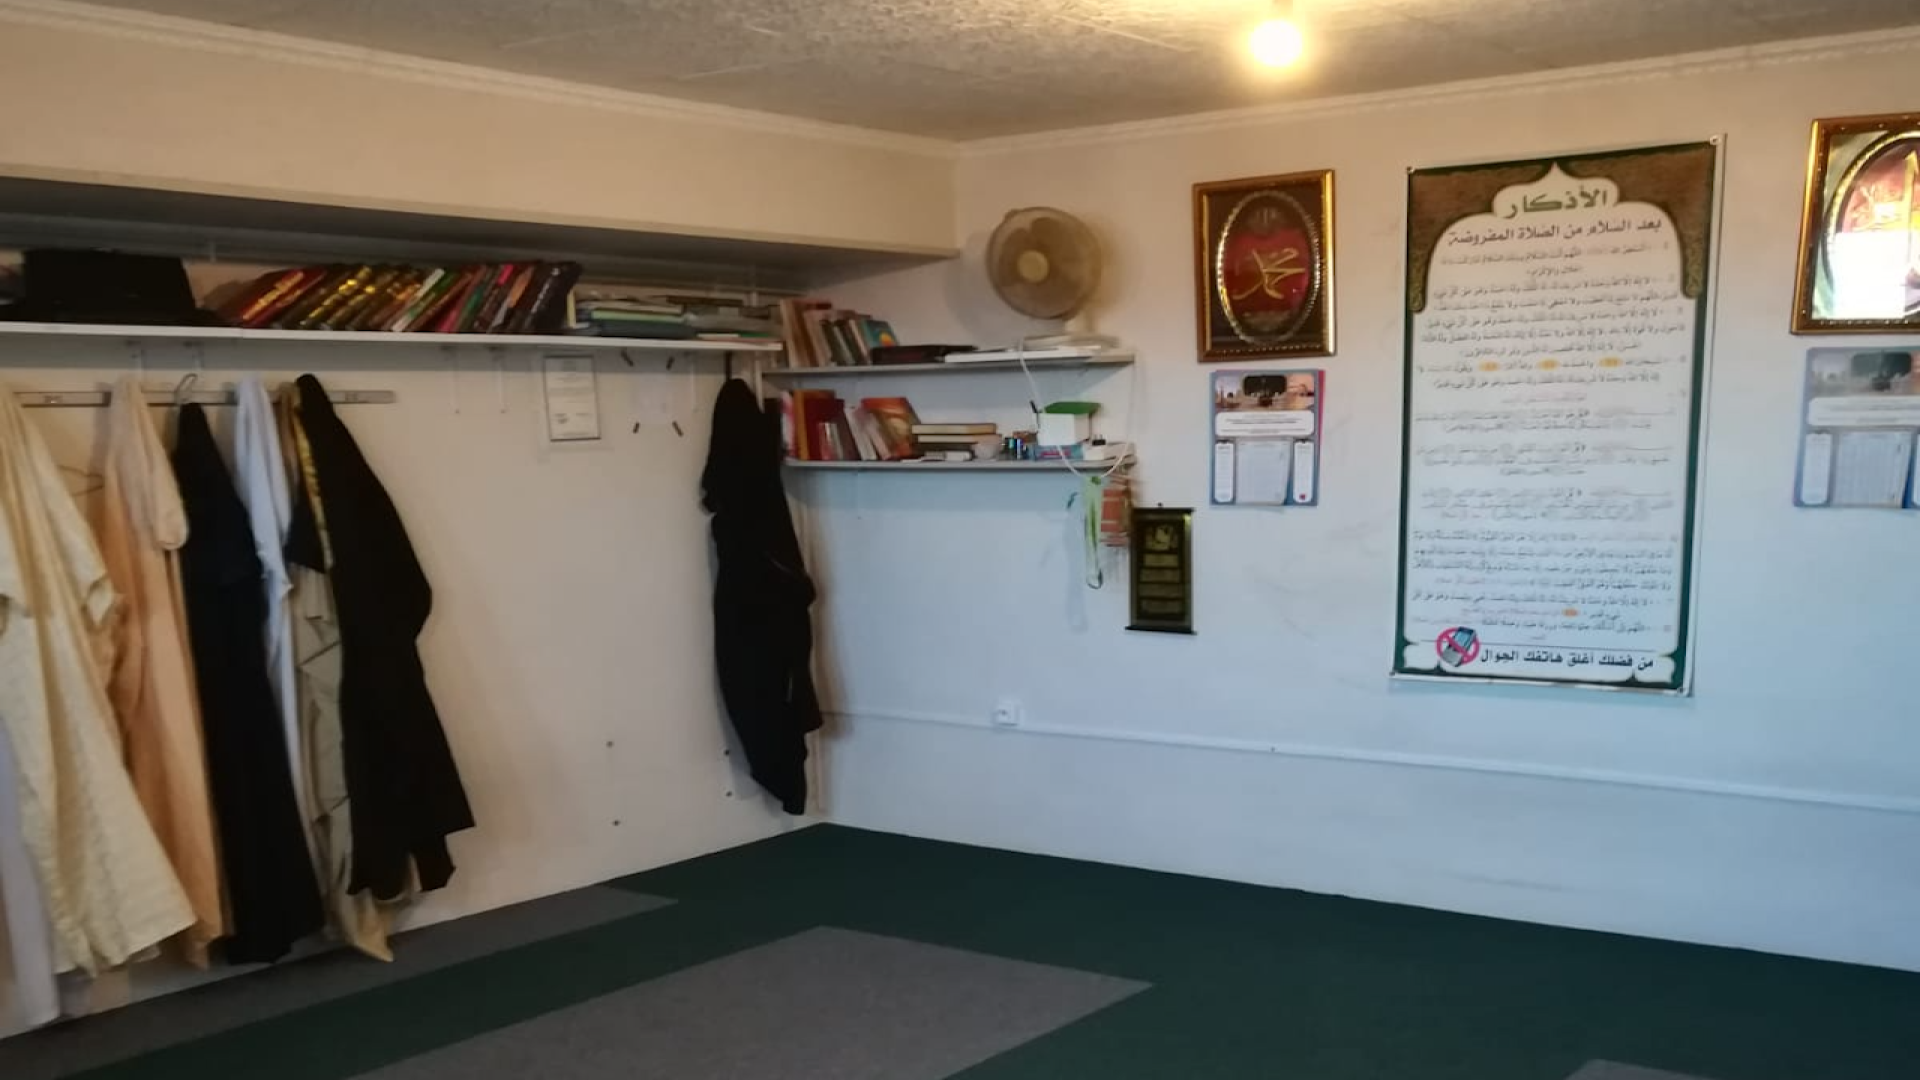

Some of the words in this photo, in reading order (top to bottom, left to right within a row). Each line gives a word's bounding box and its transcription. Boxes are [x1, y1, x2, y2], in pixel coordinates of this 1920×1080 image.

[1502, 185, 1607, 219] الأذكار
[1563, 223, 1582, 239] من
[1637, 219, 1662, 234] بعد
[1447, 227, 1515, 246] المفروضة
[1480, 648, 1519, 663] الجوال
[1523, 649, 1563, 663] هاتفك
[1598, 654, 1633, 667] فضلك
[1637, 656, 1654, 671] من
